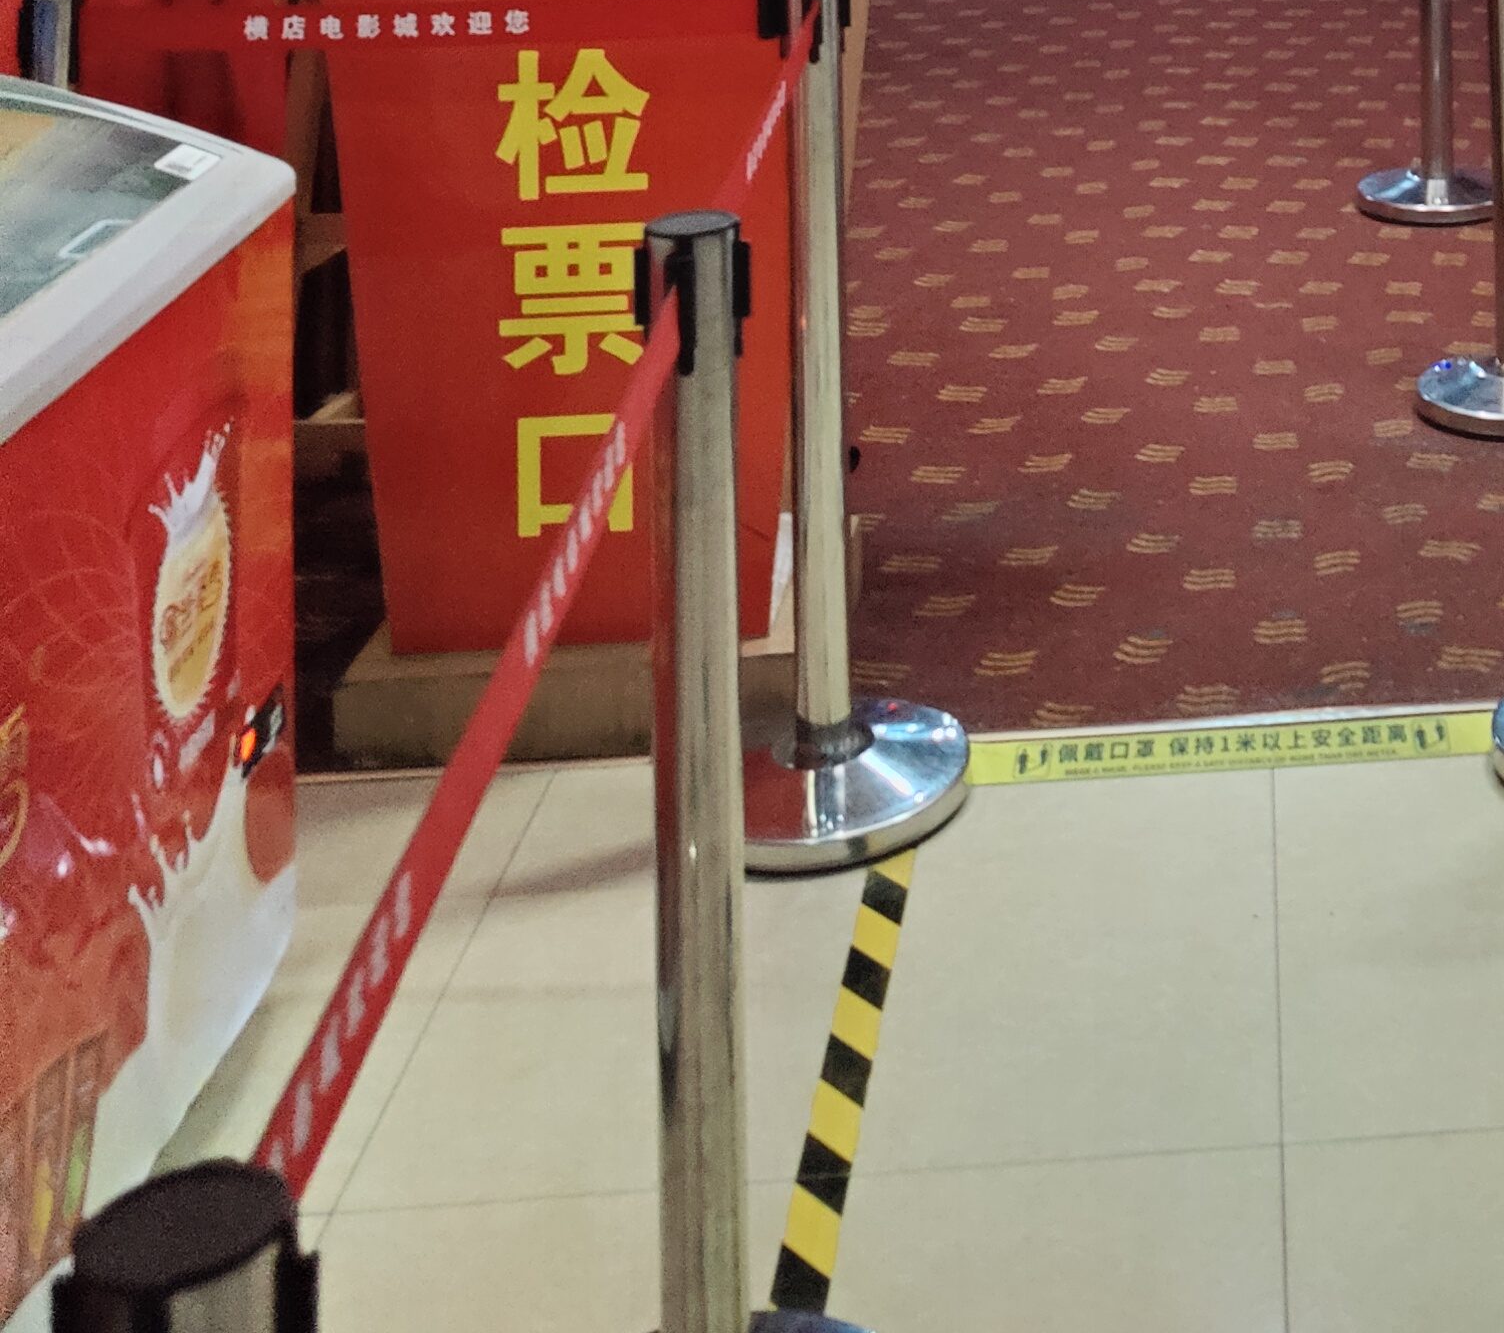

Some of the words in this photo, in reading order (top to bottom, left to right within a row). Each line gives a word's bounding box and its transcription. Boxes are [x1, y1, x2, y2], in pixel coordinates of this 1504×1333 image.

[243, 8, 531, 41] 横店电影城欢迎您
[495, 47, 651, 539] 检票口
